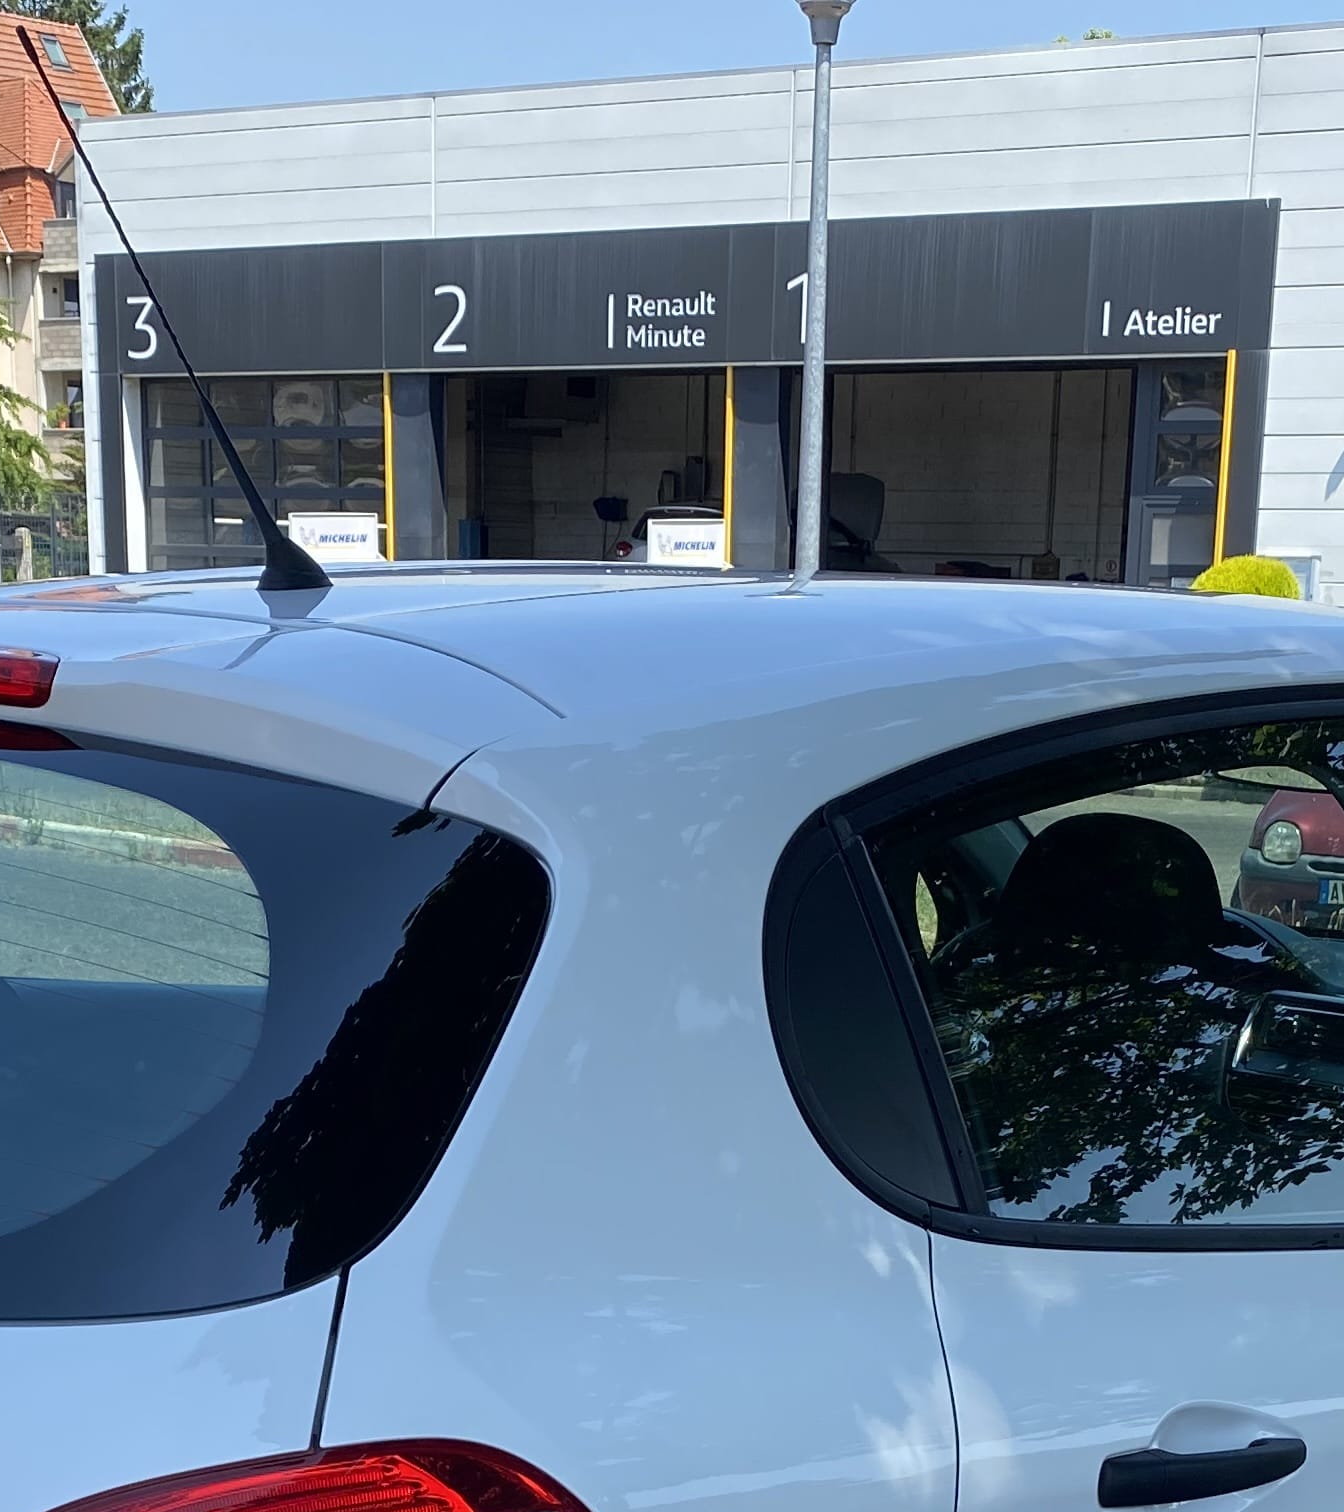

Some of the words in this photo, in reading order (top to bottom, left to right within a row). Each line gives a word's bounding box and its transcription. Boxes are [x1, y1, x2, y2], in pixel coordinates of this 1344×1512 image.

[625, 290, 717, 318] Renault
[126, 295, 158, 360] 3
[432, 285, 468, 353] 2
[1123, 308, 1222, 337] Atelier
[625, 324, 706, 349] Minute
[319, 533, 368, 543] MICHELIN
[673, 540, 716, 551] MICHELIN
